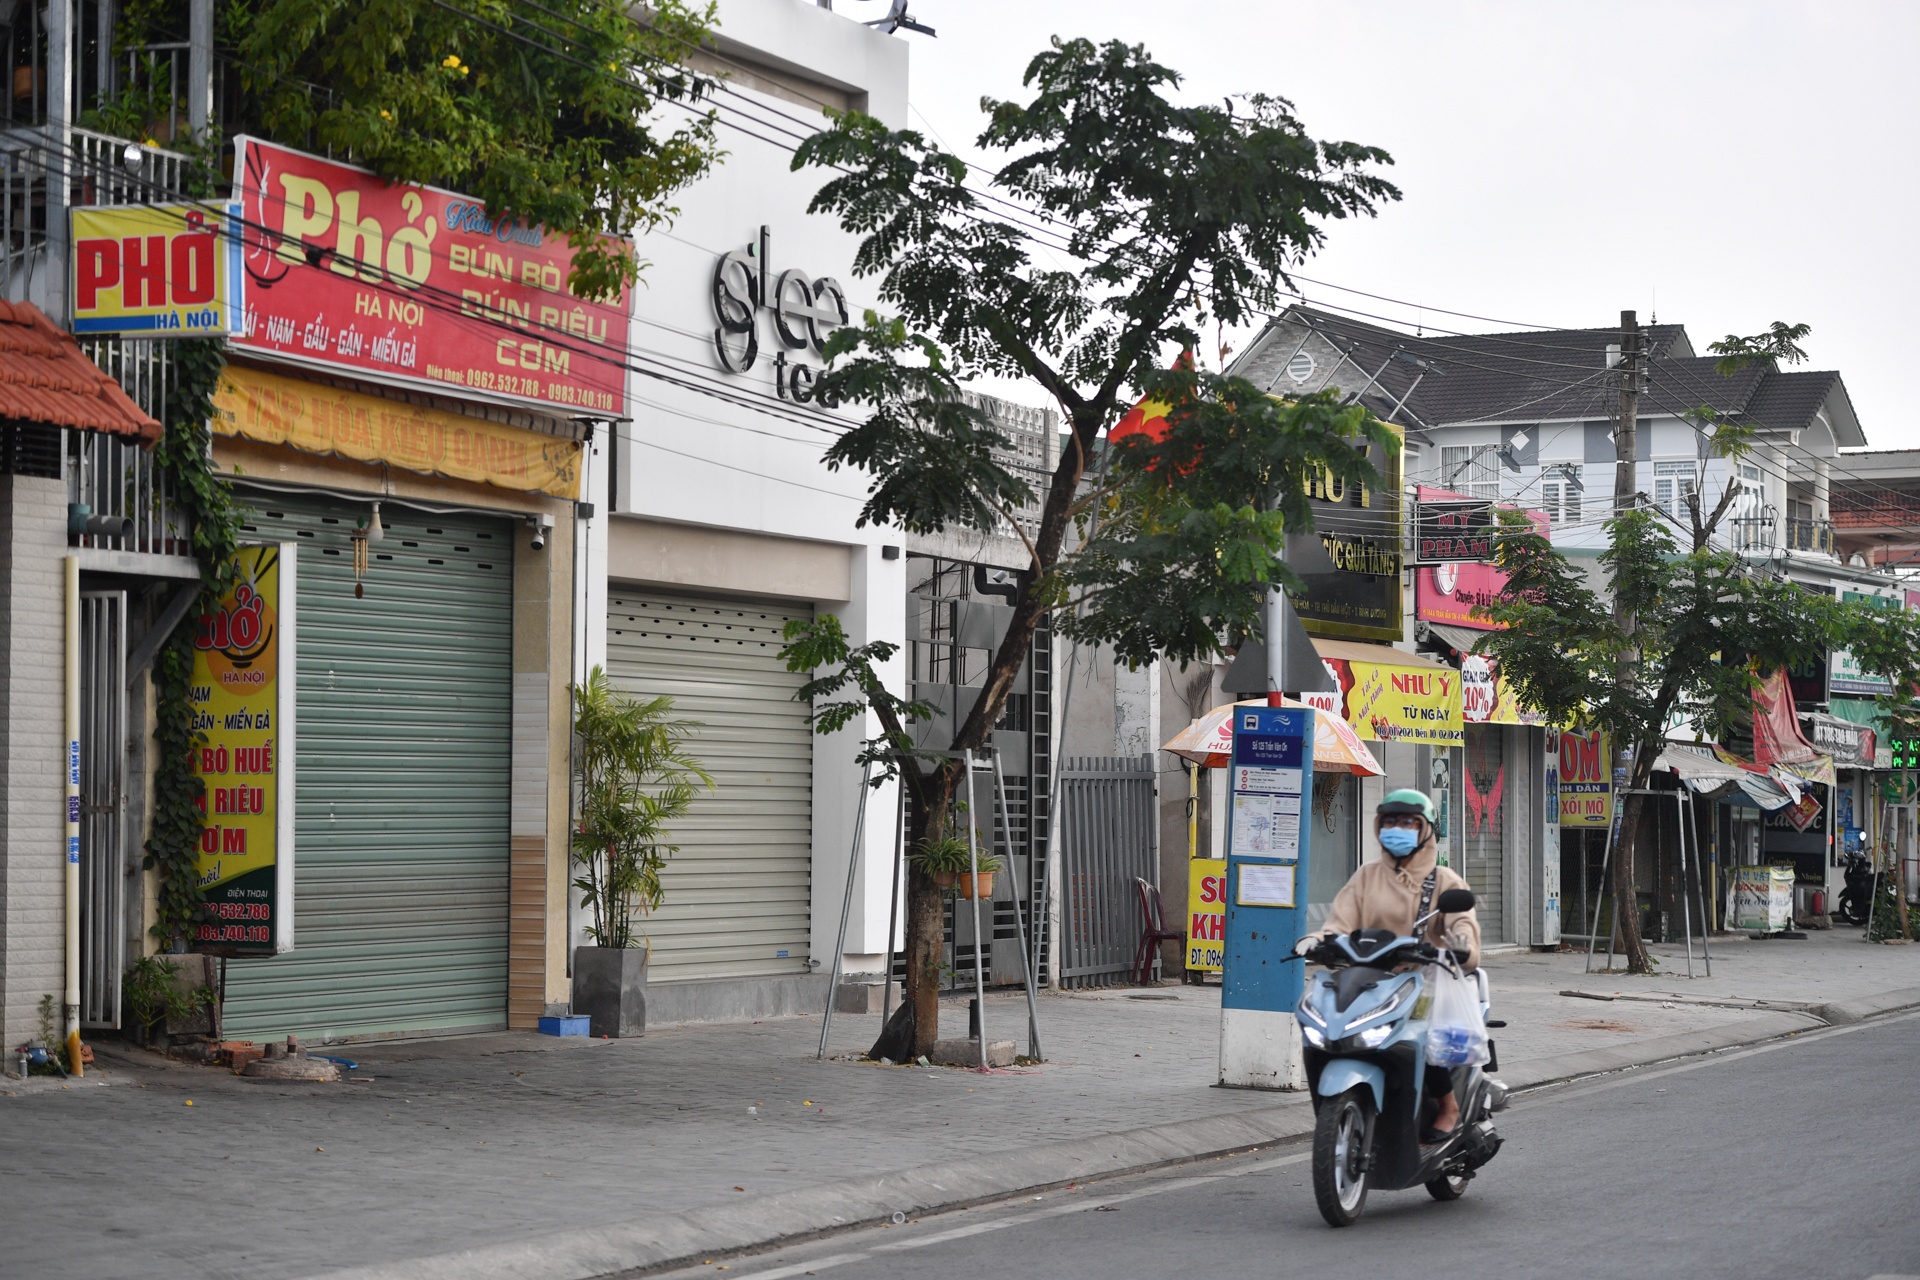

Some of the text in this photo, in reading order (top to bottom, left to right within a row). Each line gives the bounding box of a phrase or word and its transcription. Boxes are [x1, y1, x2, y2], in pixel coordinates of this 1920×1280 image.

[275, 172, 438, 291] Phở
[496, 214, 542, 248] Oanh
[77, 210, 220, 310] PHỞ
[449, 243, 513, 284] BÚN
[520, 260, 561, 294] BÒ
[155, 308, 219, 331] HÀ NỘI
[355, 291, 425, 330] HÀ NỘI
[460, 289, 608, 345] BÚN RIÊU
[244, 302, 417, 368] ÁI NẠM GẦU GÂN MIẾN GÀ
[496, 339, 570, 376] CƠM
[466, 368, 540, 398] 0962.532.788
[548, 383, 614, 411] 0983.740.118
[247, 385, 304, 439] TẠP
[311, 392, 374, 449] HÓA
[453, 427, 530, 480] OANH
[1436, 507, 1473, 529] MỸ
[1345, 536, 1367, 572] QUÀ
[1421, 530, 1488, 558] PHẨM
[195, 585, 263, 650] hở
[223, 669, 265, 685] HÀ NỘI
[1391, 672, 1450, 697] NHƯ Ý
[1403, 704, 1450, 721] TỪ NGÀY
[1464, 687, 1489, 712] 10%
[191, 707, 270, 731] GÂN MIẾN GÀ
[201, 744, 230, 775] BÒ
[234, 740, 274, 775] HUẾ
[1207, 741, 1232, 750] HU
[215, 783, 265, 816] RIÊU
[1576, 783, 1600, 792] DÂN
[1561, 795, 1605, 815] XỐI MỠ
[192, 825, 247, 855] ƠM
[227, 887, 269, 900] ĐIỆN THOẠI
[1191, 948, 1204, 965] ĐT:
